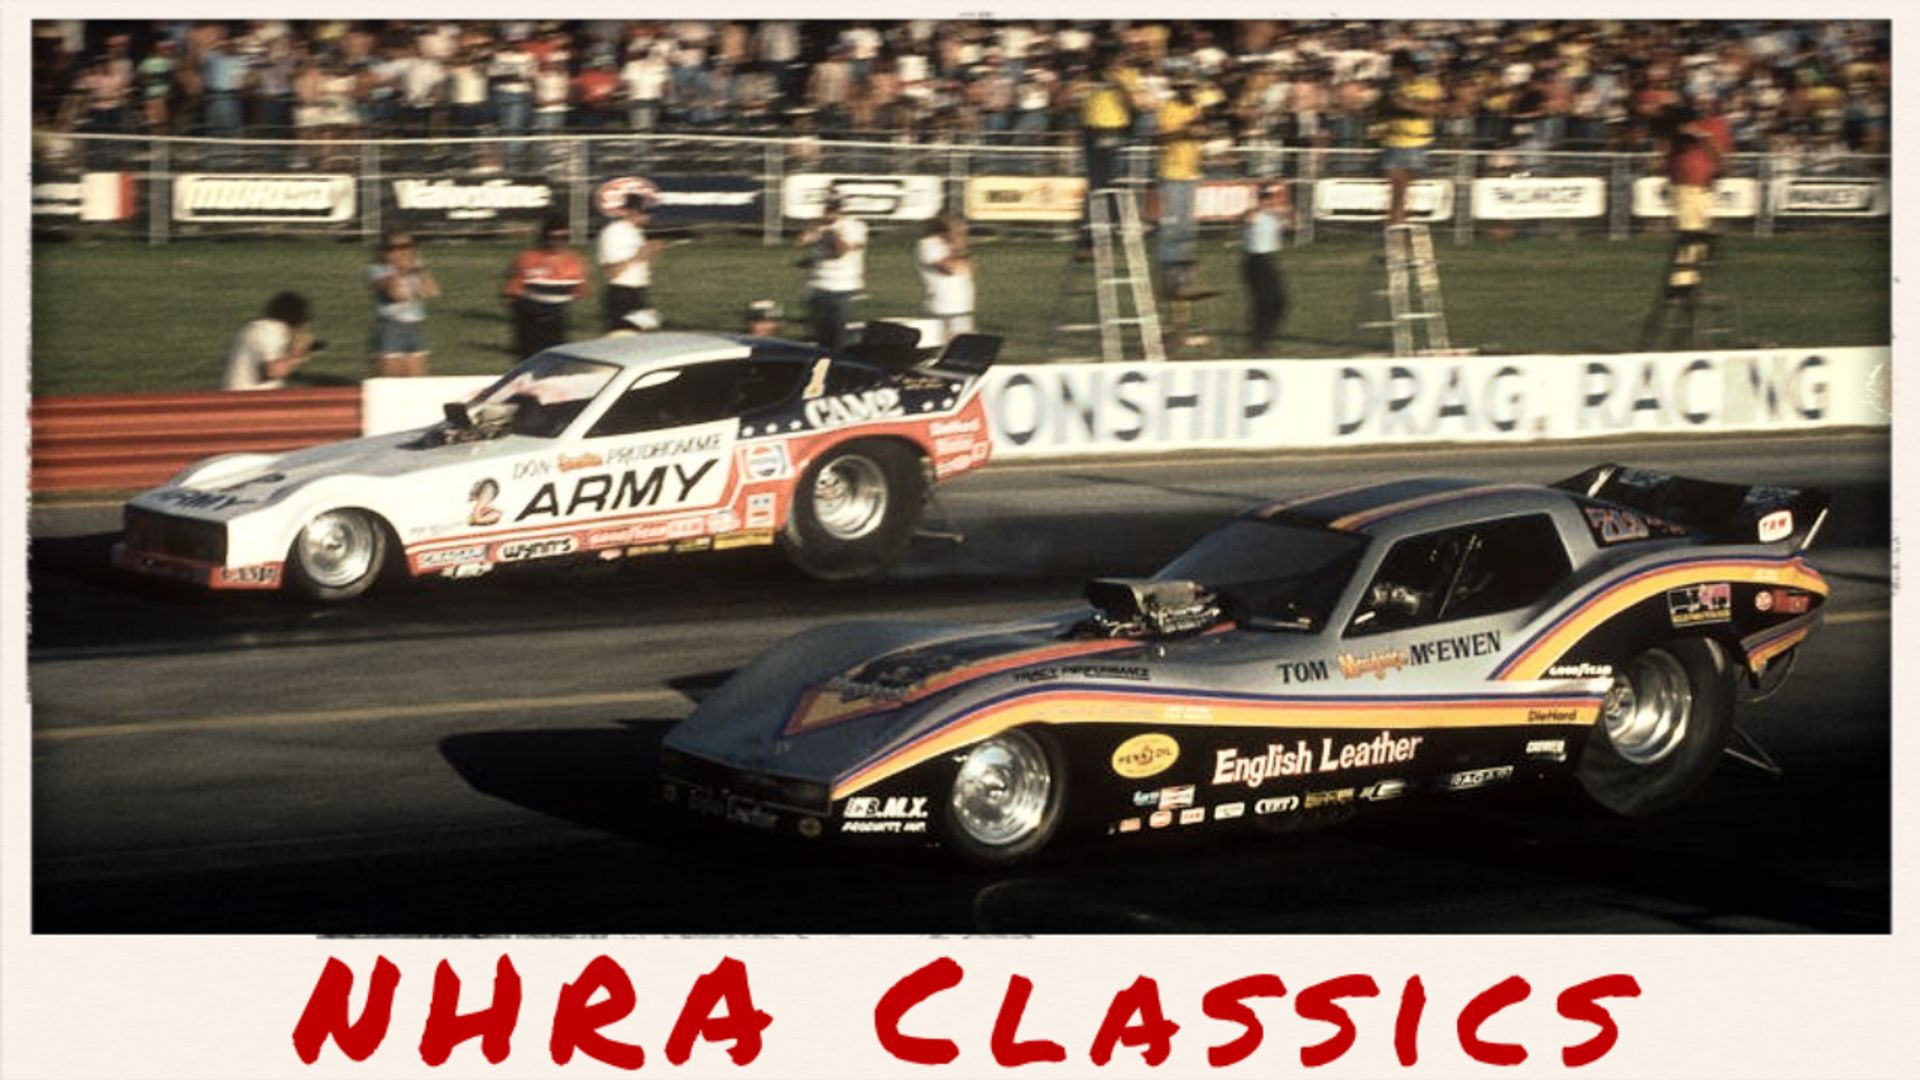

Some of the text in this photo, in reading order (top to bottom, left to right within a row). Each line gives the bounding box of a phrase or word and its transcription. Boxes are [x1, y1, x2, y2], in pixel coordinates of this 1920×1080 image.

[515, 458, 719, 521] ARMY
[1278, 659, 1329, 685] TOM
[1528, 709, 1577, 722] DieHard
[1212, 730, 1423, 788] English Leather
